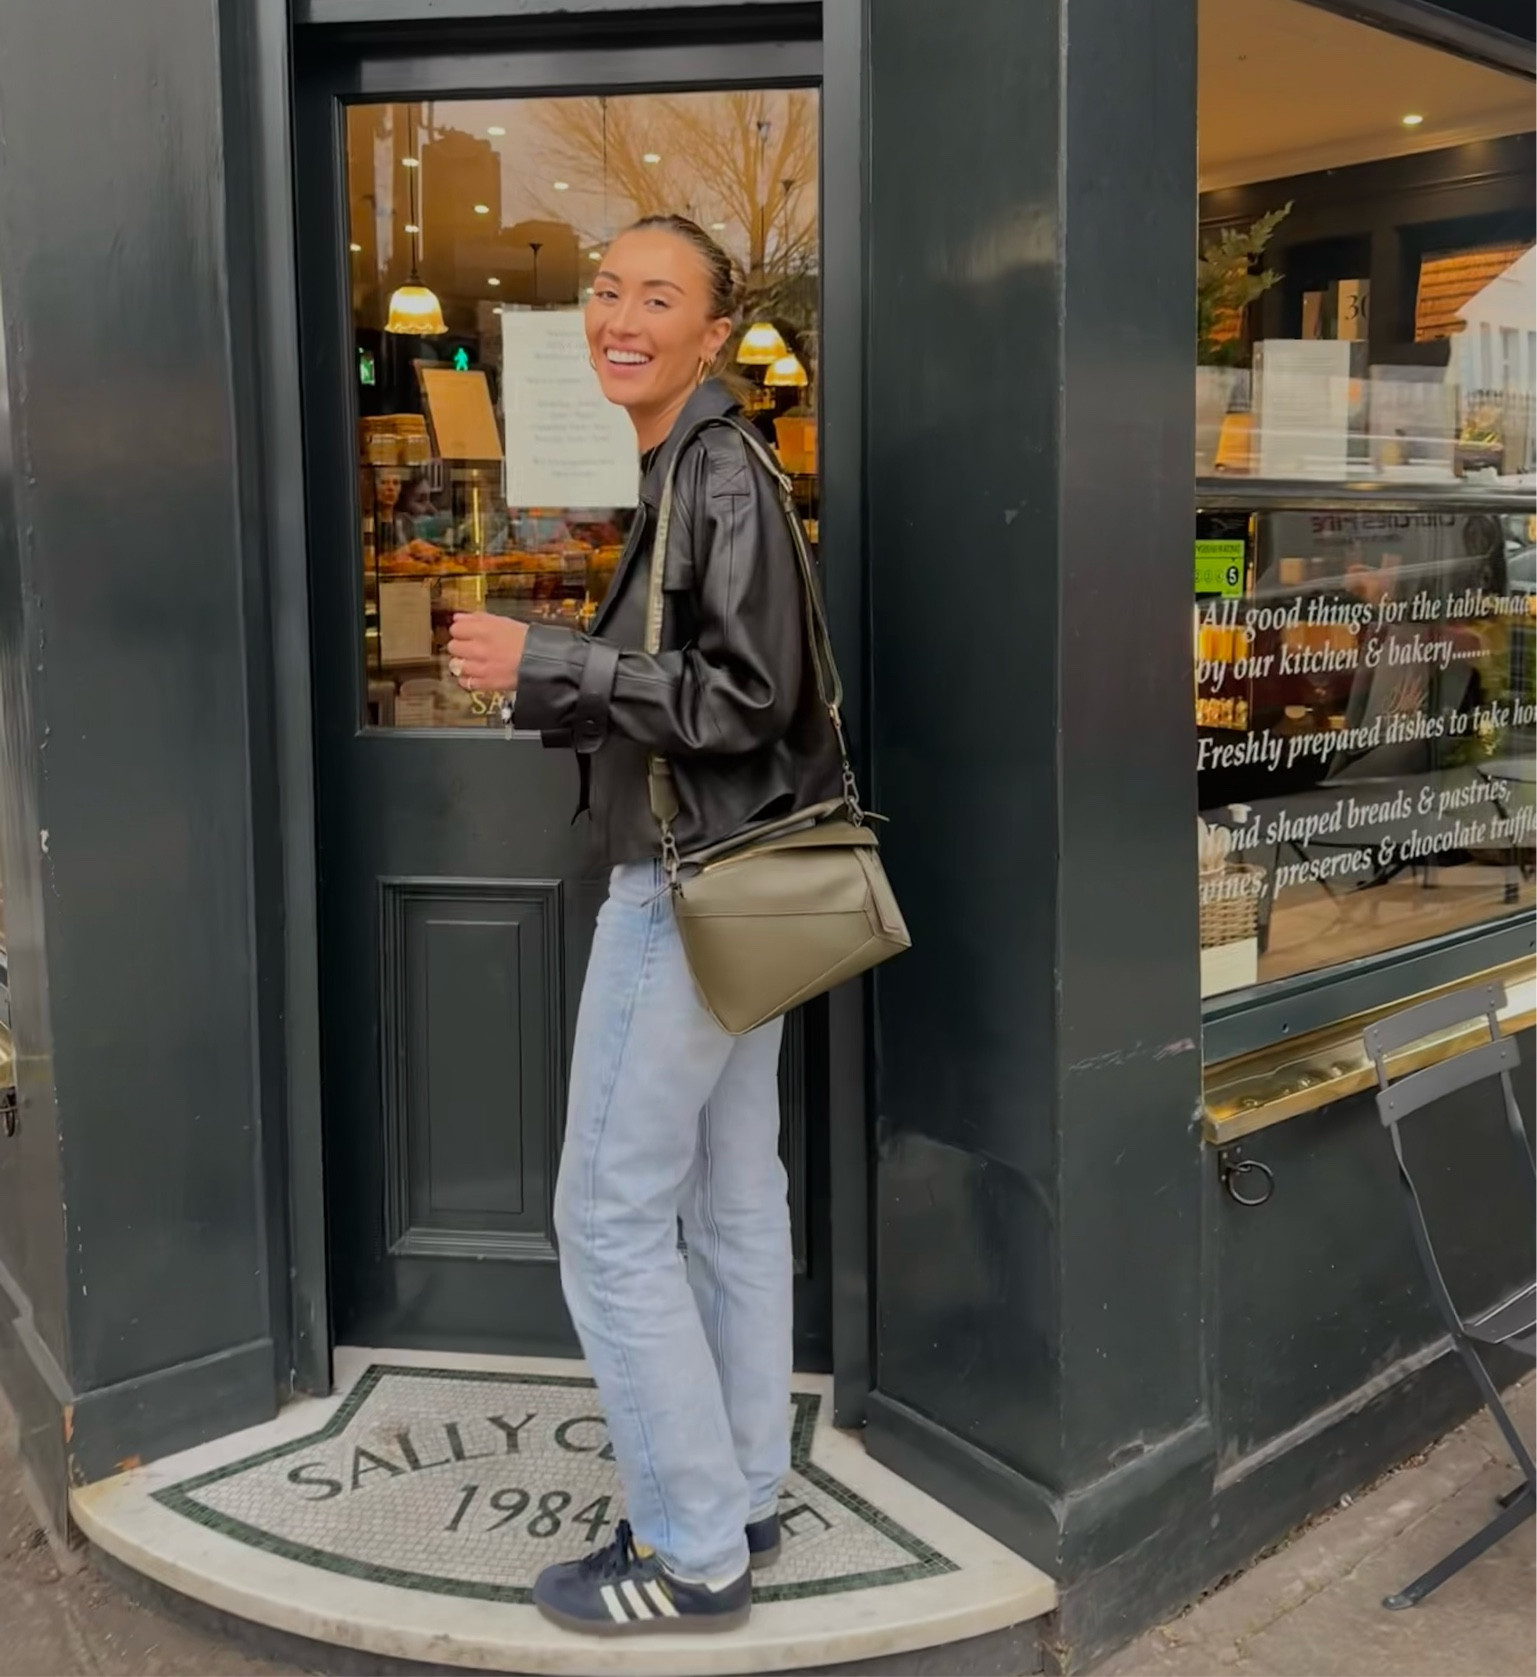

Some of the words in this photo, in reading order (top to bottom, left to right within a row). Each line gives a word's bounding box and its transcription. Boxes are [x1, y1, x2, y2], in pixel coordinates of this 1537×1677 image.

[1228, 567, 1238, 586] 5
[1203, 600, 1239, 632] All
[1245, 596, 1302, 642] good
[1307, 595, 1372, 634] things
[1373, 592, 1406, 634] for
[1411, 590, 1440, 621] the
[1445, 587, 1491, 618] table
[1233, 653, 1274, 680] our
[1279, 641, 1359, 677] kitchen
[1364, 636, 1384, 668] &
[1196, 729, 1282, 773] Freshly
[1287, 716, 1382, 768] prepared
[1386, 709, 1445, 745] dishes
[1449, 708, 1468, 735] to
[1473, 700, 1510, 732] take
[1513, 698, 1535, 725] ho
[1266, 800, 1343, 846] shaped
[1348, 789, 1412, 830] breads
[1418, 785, 1436, 814] &
[1439, 775, 1512, 820] pastries,
[1274, 846, 1372, 899] preserves
[1378, 836, 1398, 866] &
[1400, 821, 1486, 860] chocolate
[287, 1413, 537, 1501] SALLY
[443, 1483, 613, 1543] 1984
